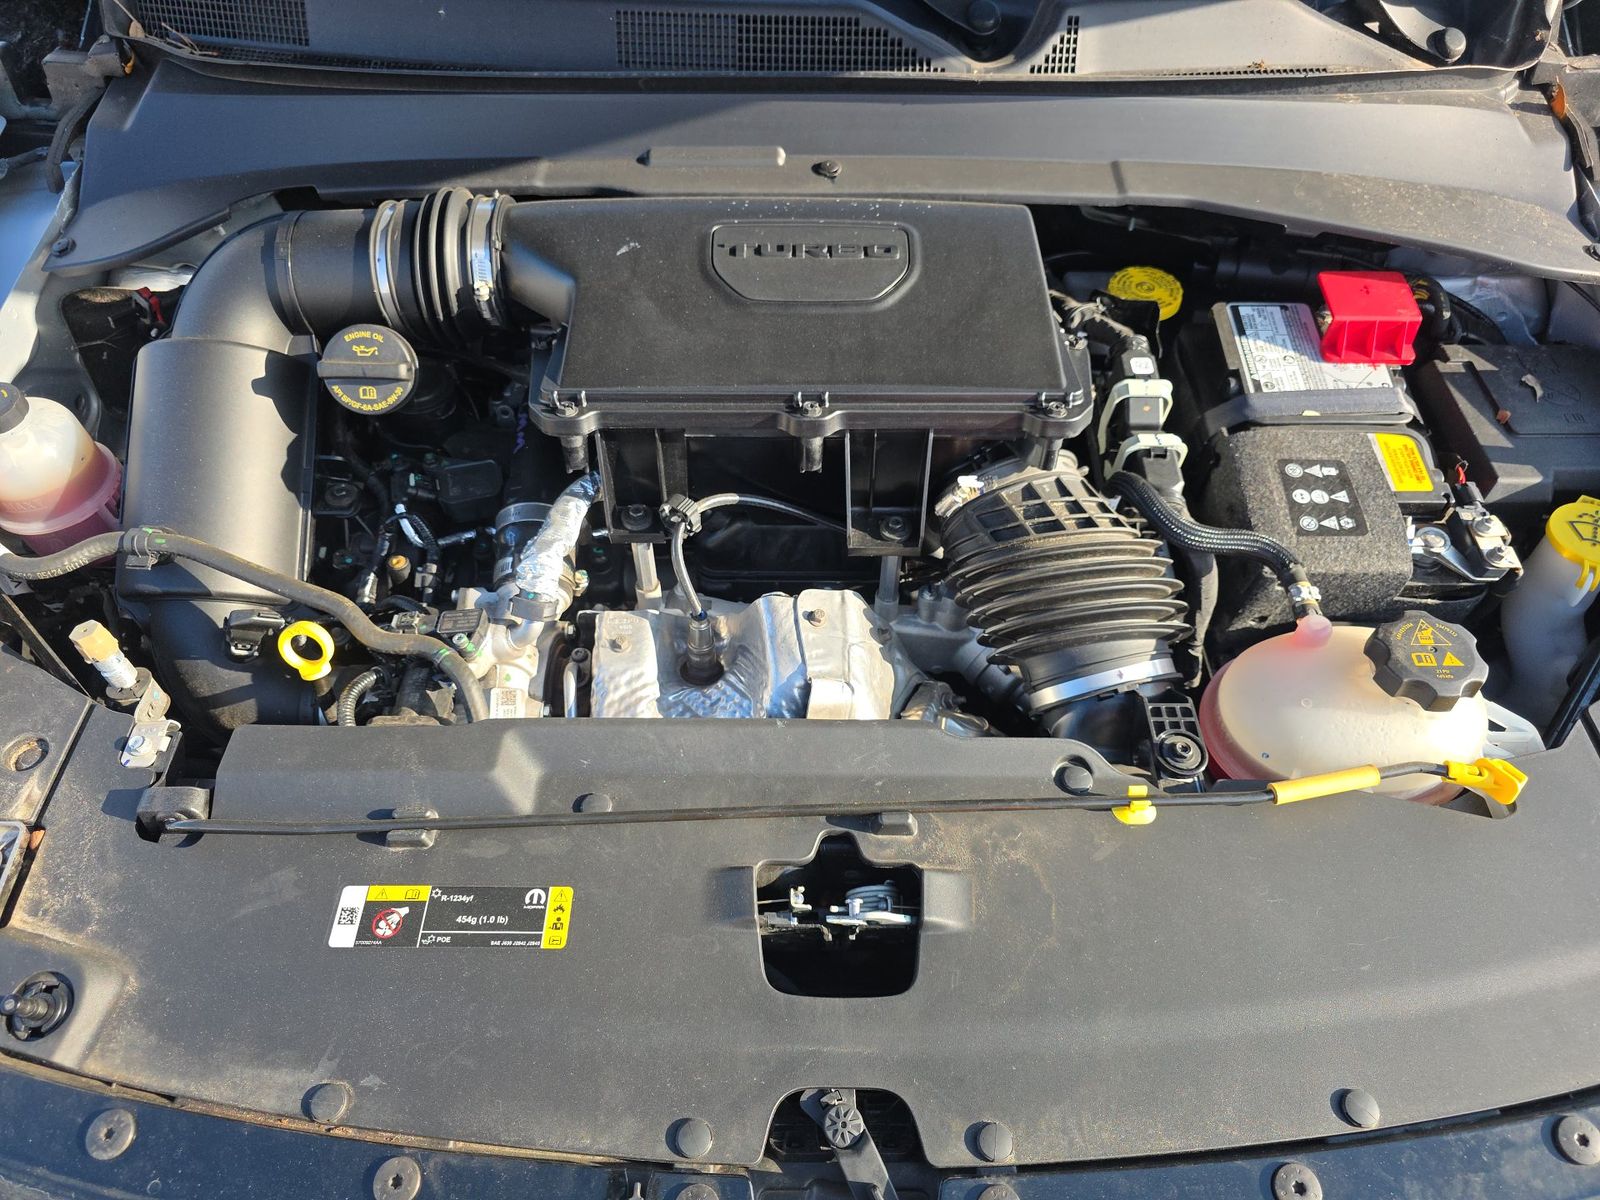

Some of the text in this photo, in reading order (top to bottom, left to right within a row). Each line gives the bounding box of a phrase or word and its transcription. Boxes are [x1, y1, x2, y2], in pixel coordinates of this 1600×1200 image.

[717, 243, 900, 259] TURBO
[344, 331, 384, 343] ENGINE OIL
[331, 385, 343, 397] API
[440, 894, 474, 904] R-1234yf
[455, 915, 509, 926] 454g (1.0 lb)
